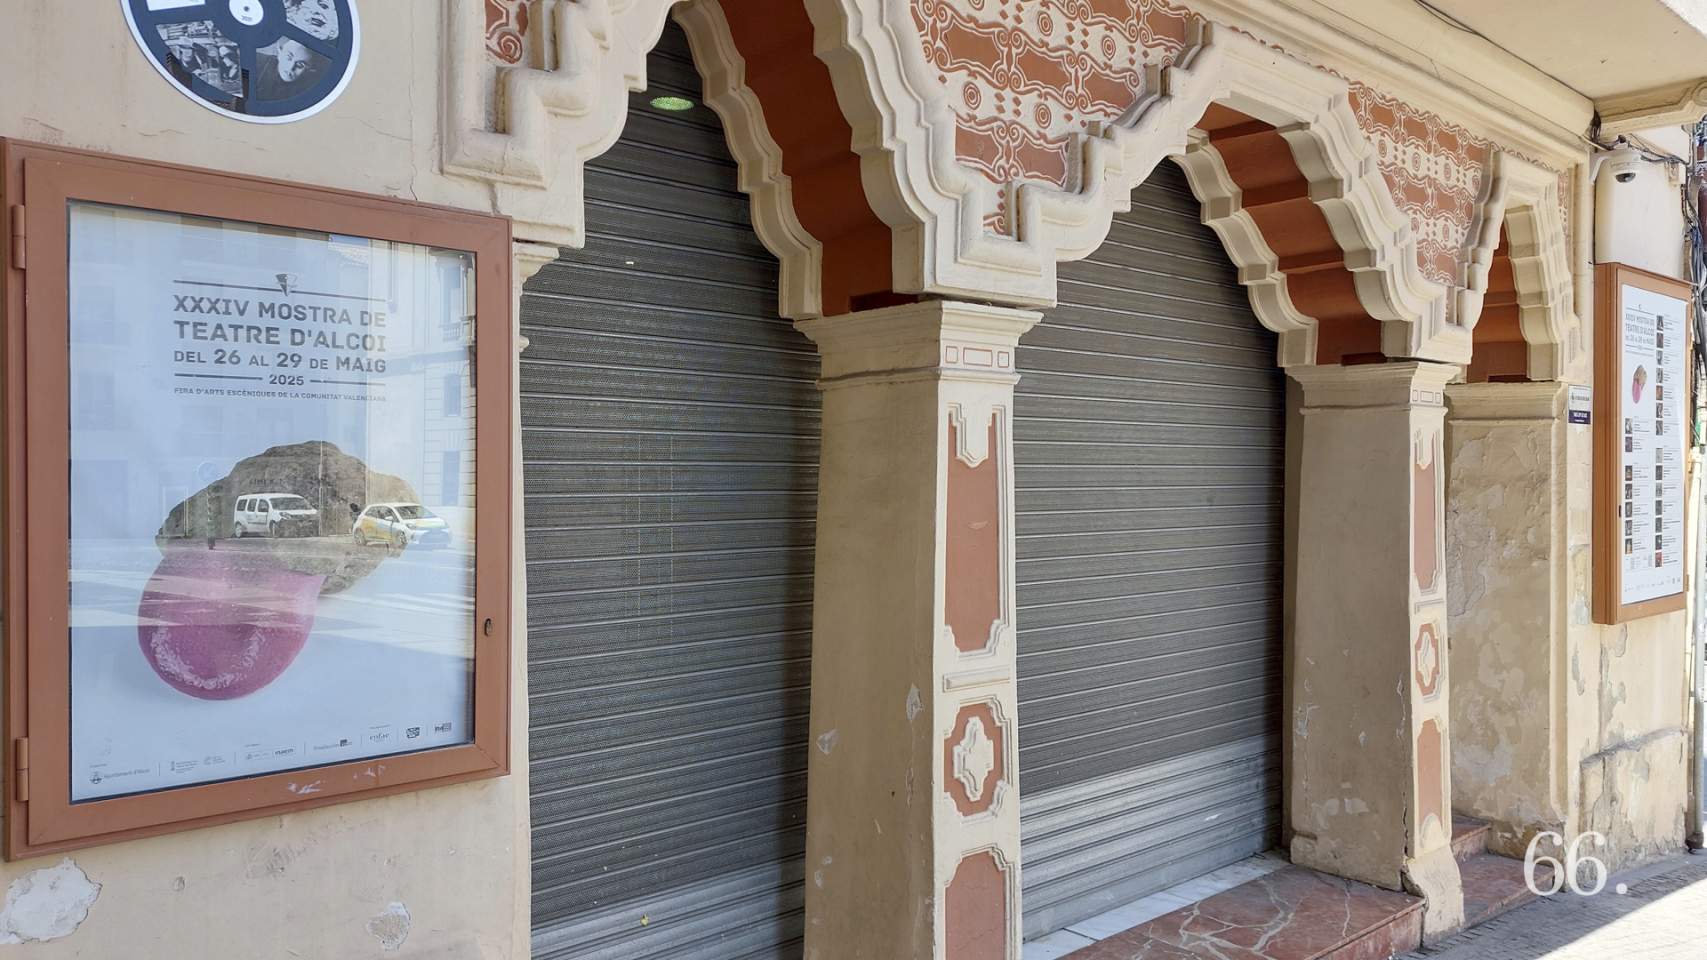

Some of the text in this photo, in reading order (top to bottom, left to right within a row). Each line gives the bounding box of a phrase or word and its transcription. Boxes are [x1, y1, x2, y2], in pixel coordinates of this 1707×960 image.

[173, 295, 386, 327] XXXIV MOSTRA DE
[174, 320, 386, 352] TEATRE D'ALCOI
[174, 349, 386, 373] DEL 26 AL 29 DE MAIG
[269, 374, 304, 385] 2025
[196, 388, 224, 396] D'ARTS
[301, 392, 341, 400] COMUNITAT
